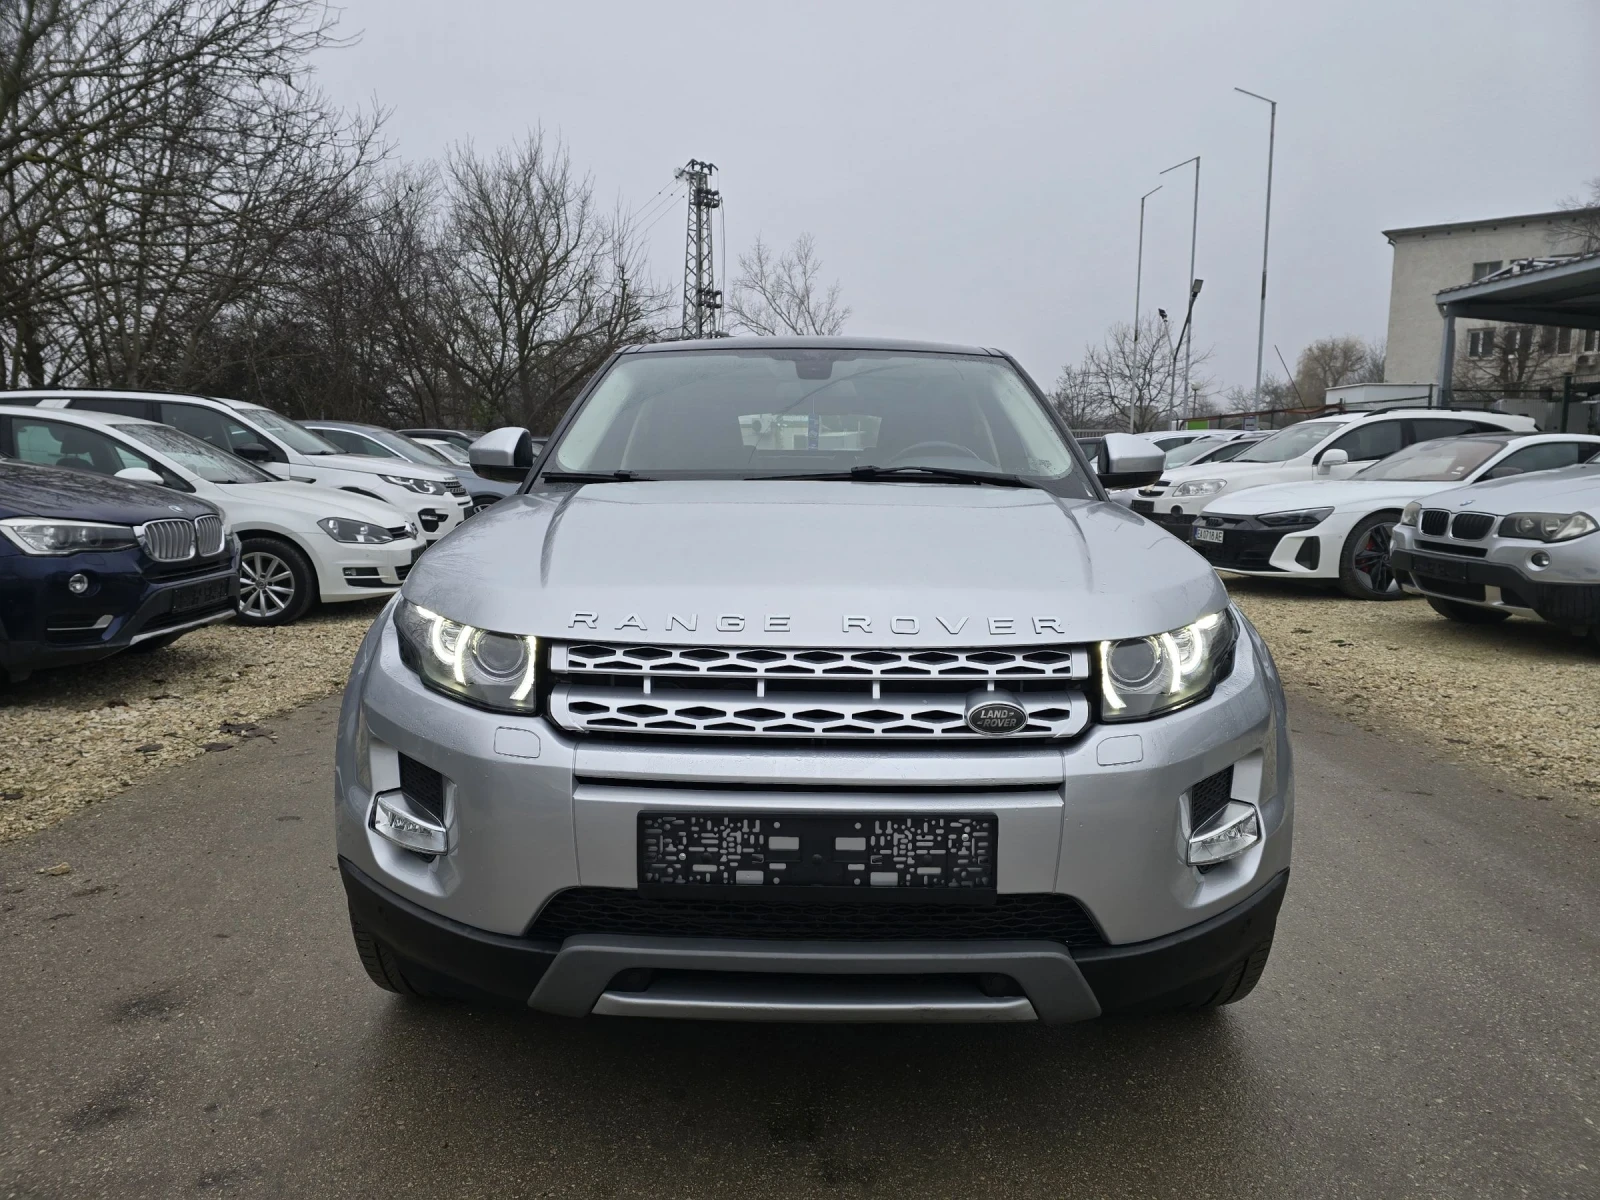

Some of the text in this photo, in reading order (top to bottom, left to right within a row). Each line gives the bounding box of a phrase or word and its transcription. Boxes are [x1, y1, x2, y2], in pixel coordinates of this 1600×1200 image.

[568, 610, 1065, 635] RANGE ROVER
[980, 709, 1008, 719] LAND
[983, 718, 1017, 727] ROVER
